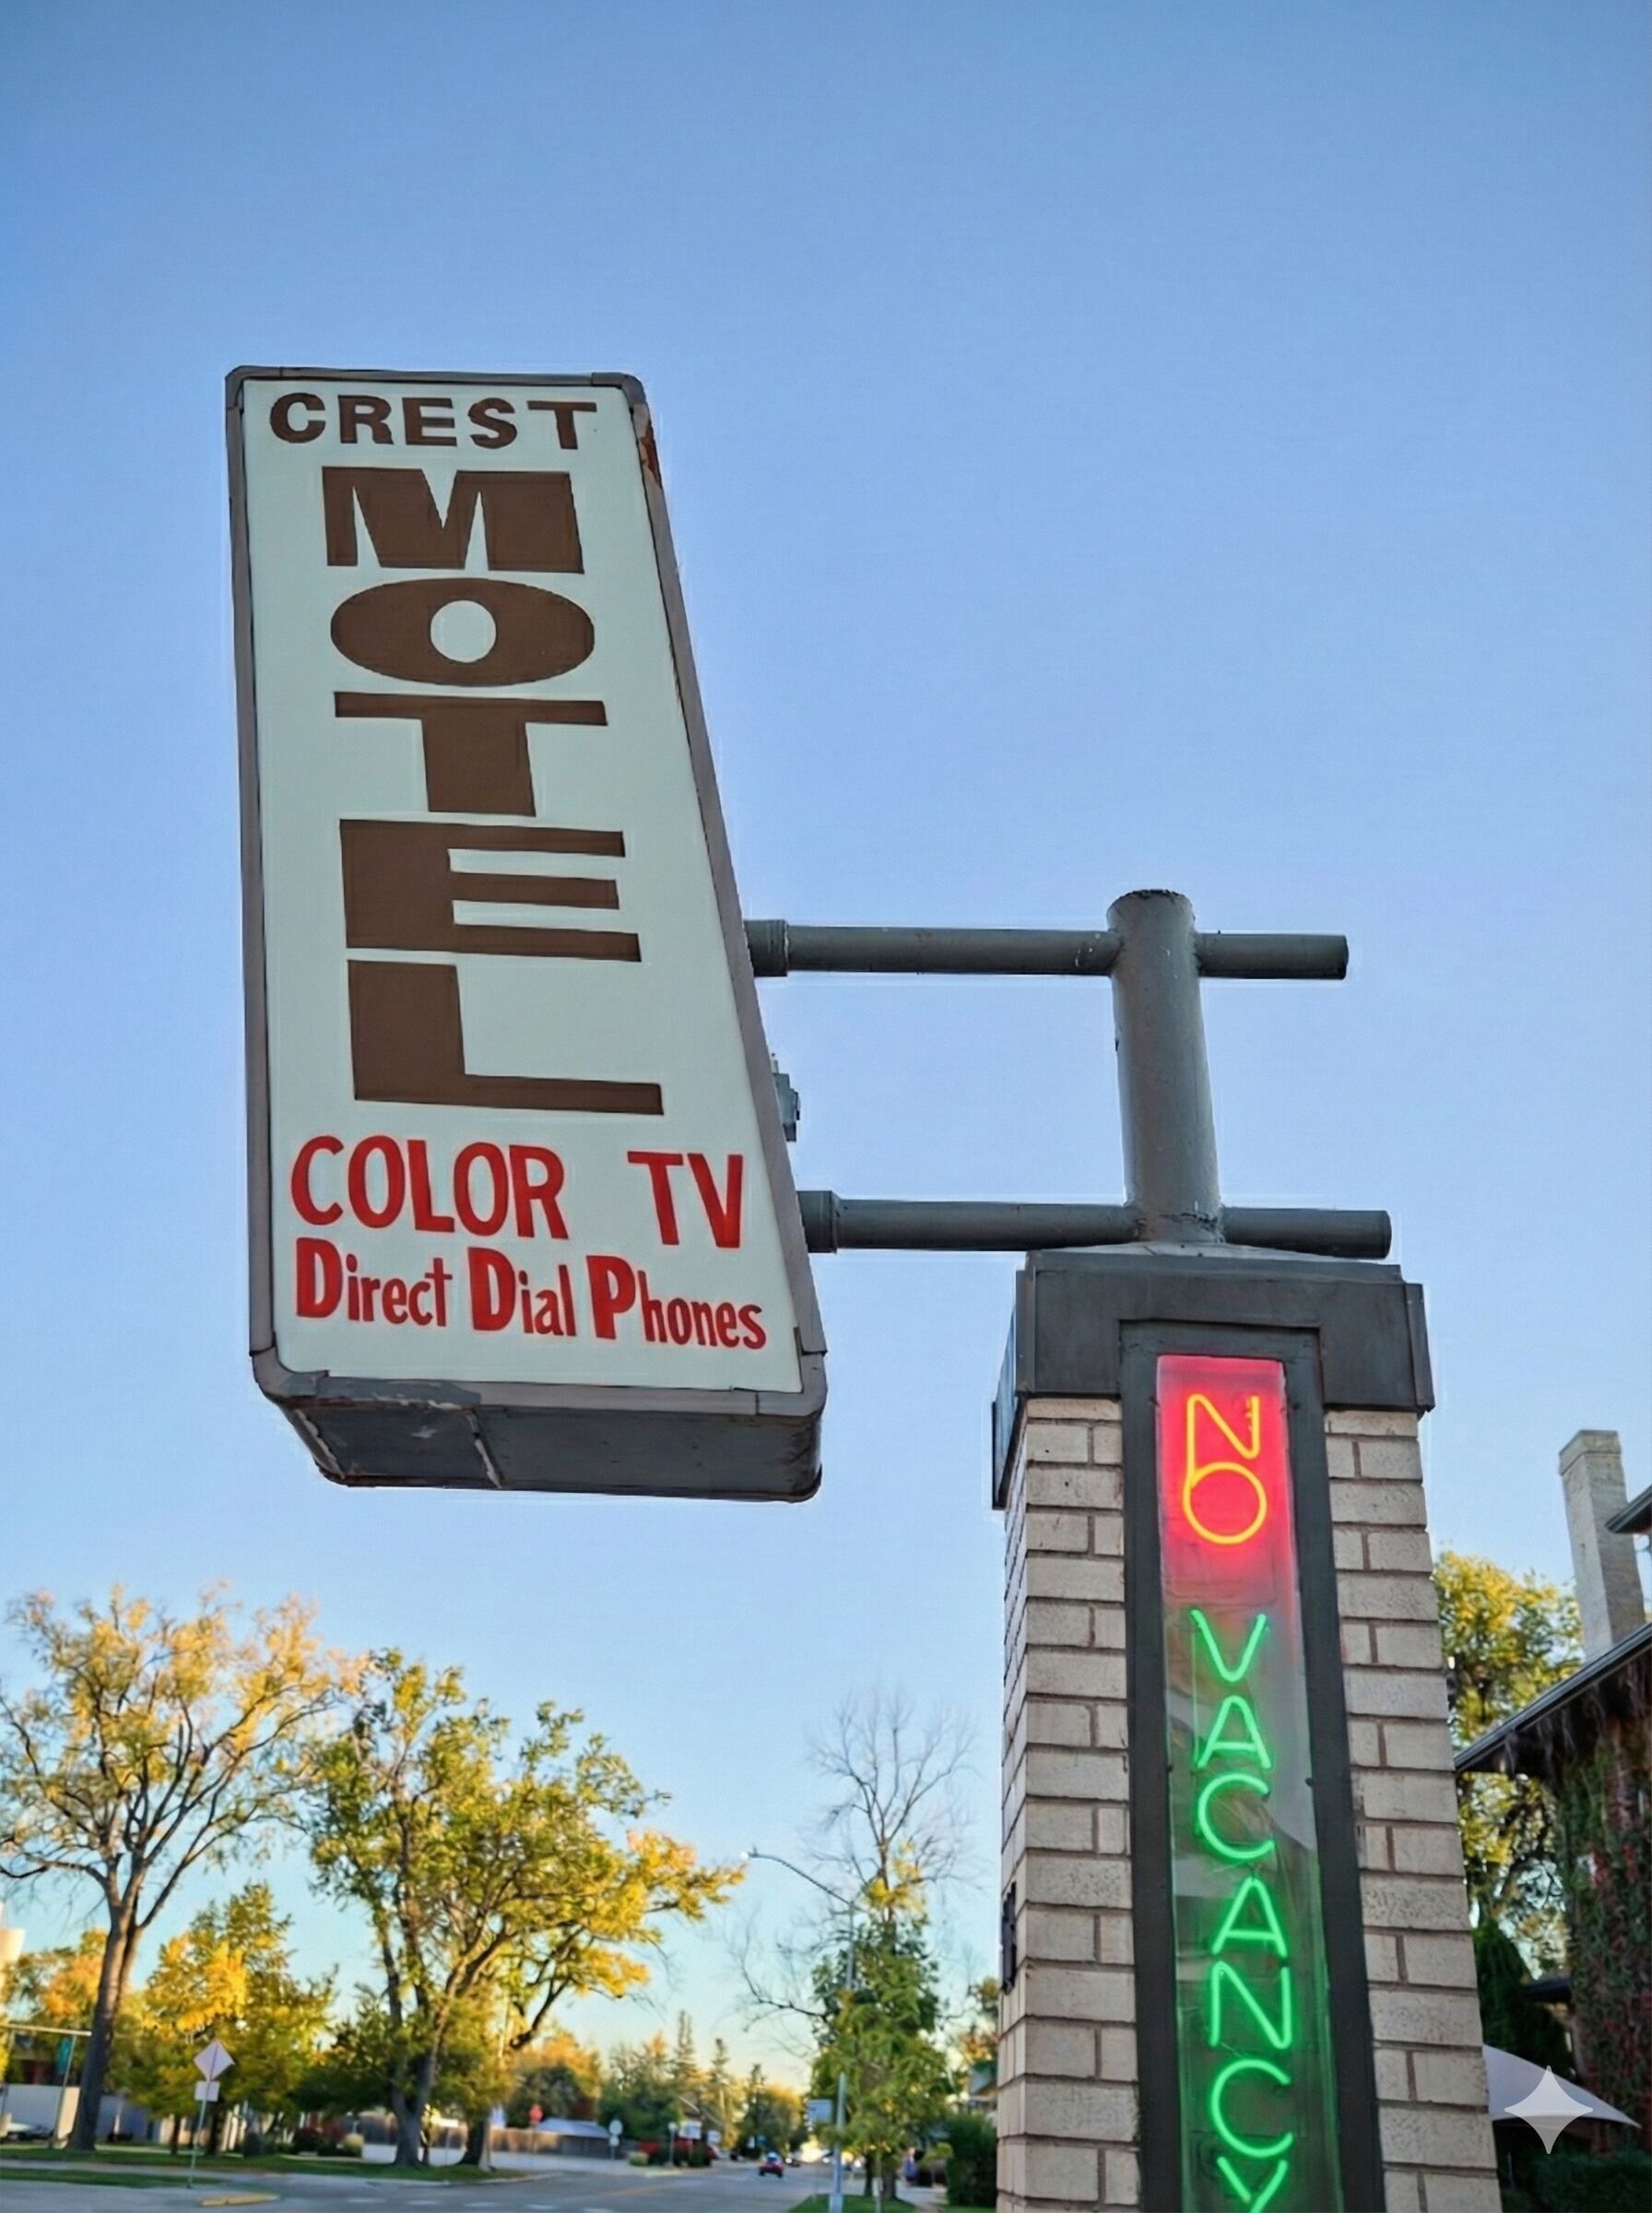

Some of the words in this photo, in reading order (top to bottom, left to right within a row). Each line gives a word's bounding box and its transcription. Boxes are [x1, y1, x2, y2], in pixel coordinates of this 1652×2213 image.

[269, 392, 597, 450] CREST
[322, 466, 664, 1116] MOTEL
[290, 1135, 569, 1239] COLOR
[627, 1151, 743, 1249] TV
[295, 1237, 453, 1327] Direct
[467, 1246, 576, 1337] Dial
[586, 1255, 767, 1350] Phones
[1183, 1393, 1268, 1544] NO
[1189, 1608, 1294, 2213] VACANCY
